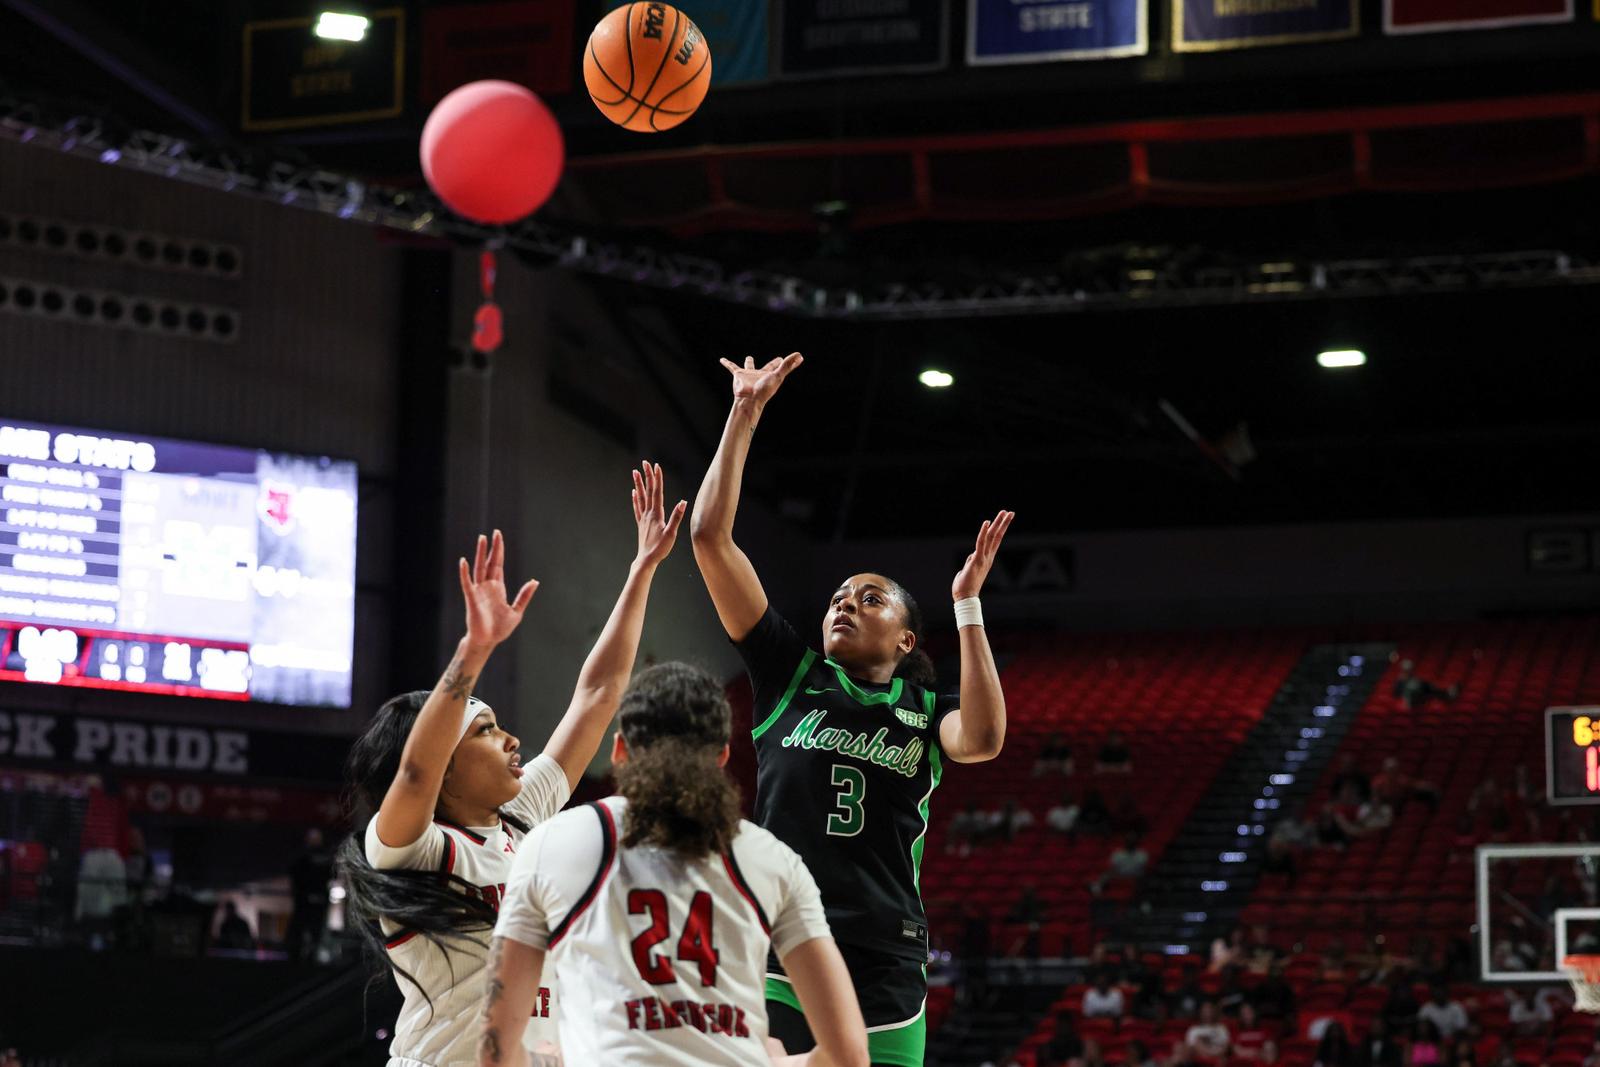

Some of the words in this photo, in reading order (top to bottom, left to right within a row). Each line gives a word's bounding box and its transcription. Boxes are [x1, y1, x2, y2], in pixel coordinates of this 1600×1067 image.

[643, 1, 666, 40] CAA
[72, 716, 249, 774] PRIDE
[782, 708, 925, 778] Marshall
[1573, 716, 1600, 746] 6:
[1586, 746, 1600, 791] 1
[826, 763, 867, 838] 3
[627, 888, 720, 987] 24
